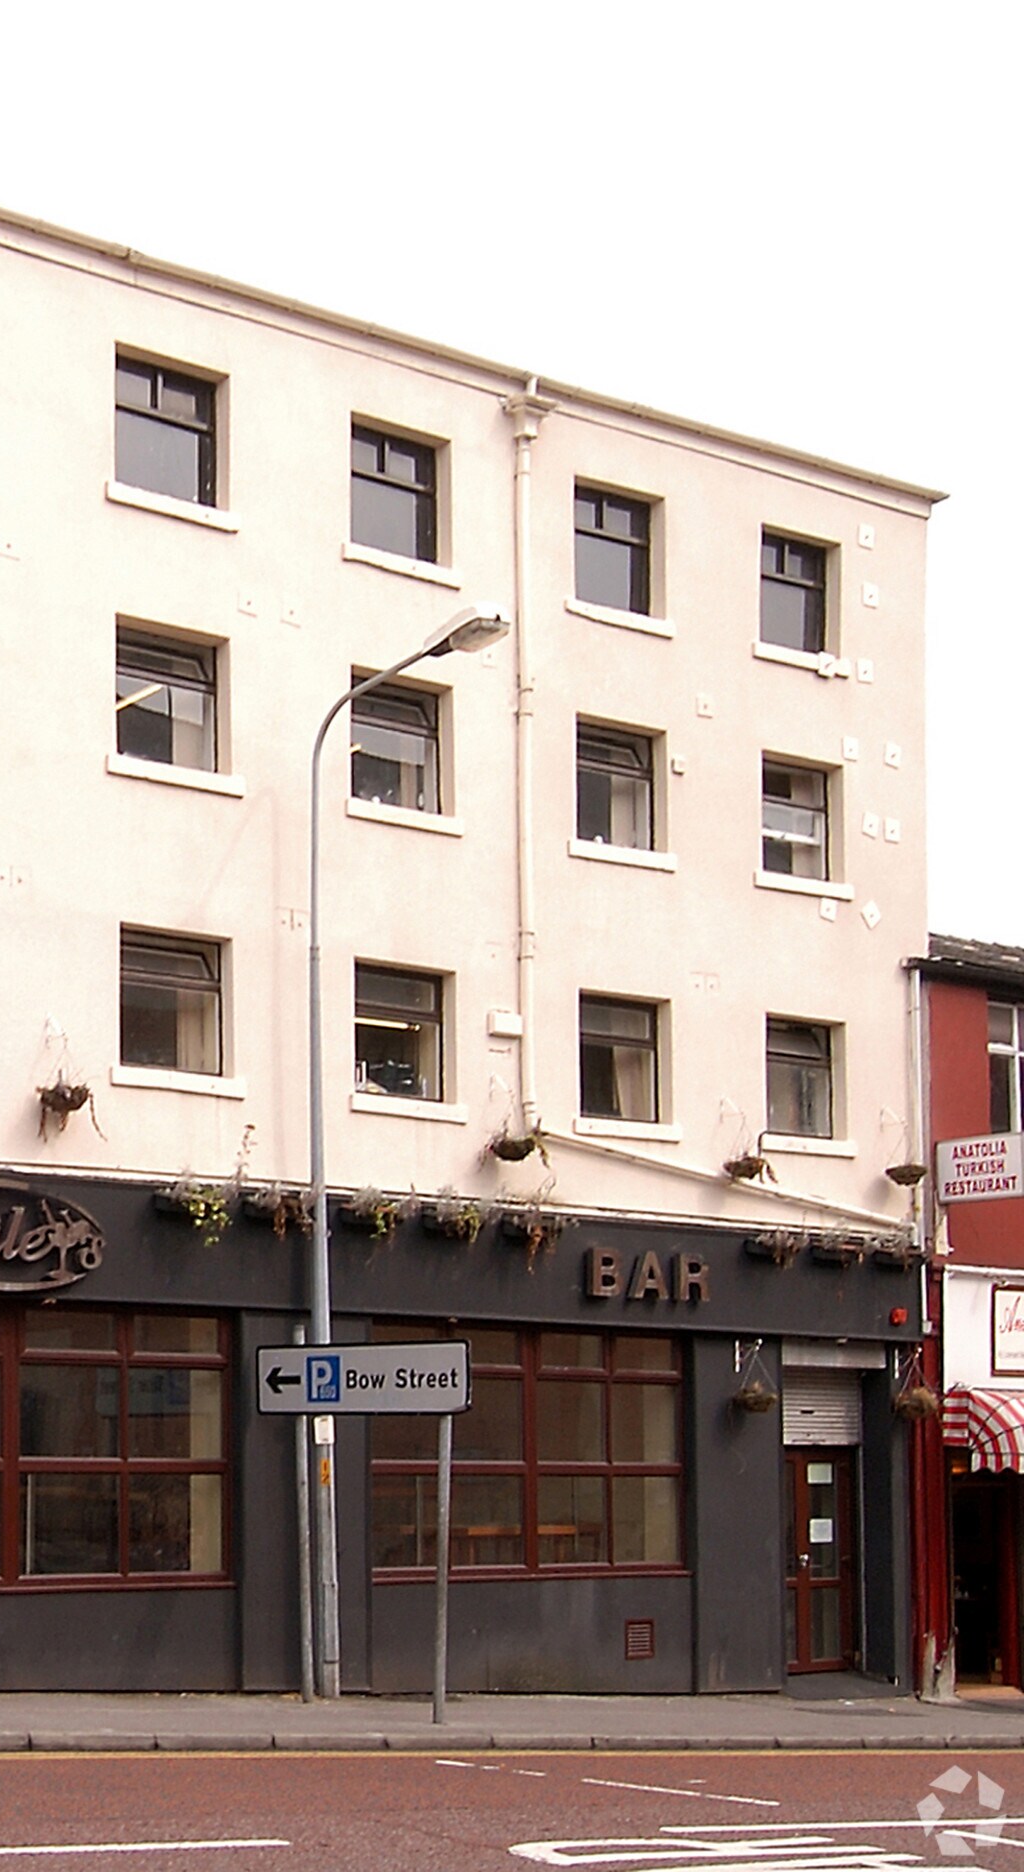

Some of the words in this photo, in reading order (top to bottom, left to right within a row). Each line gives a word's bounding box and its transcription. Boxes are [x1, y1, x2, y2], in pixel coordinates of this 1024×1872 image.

[952, 1140, 1007, 1160] ANATOLIA
[955, 1159, 1005, 1177] TURKISH
[944, 1175, 1017, 1196] RESTAURANT
[591, 1247, 711, 1302] BAR
[311, 1360, 333, 1399] P
[346, 1369, 386, 1389] Bow
[395, 1367, 458, 1389] Street
